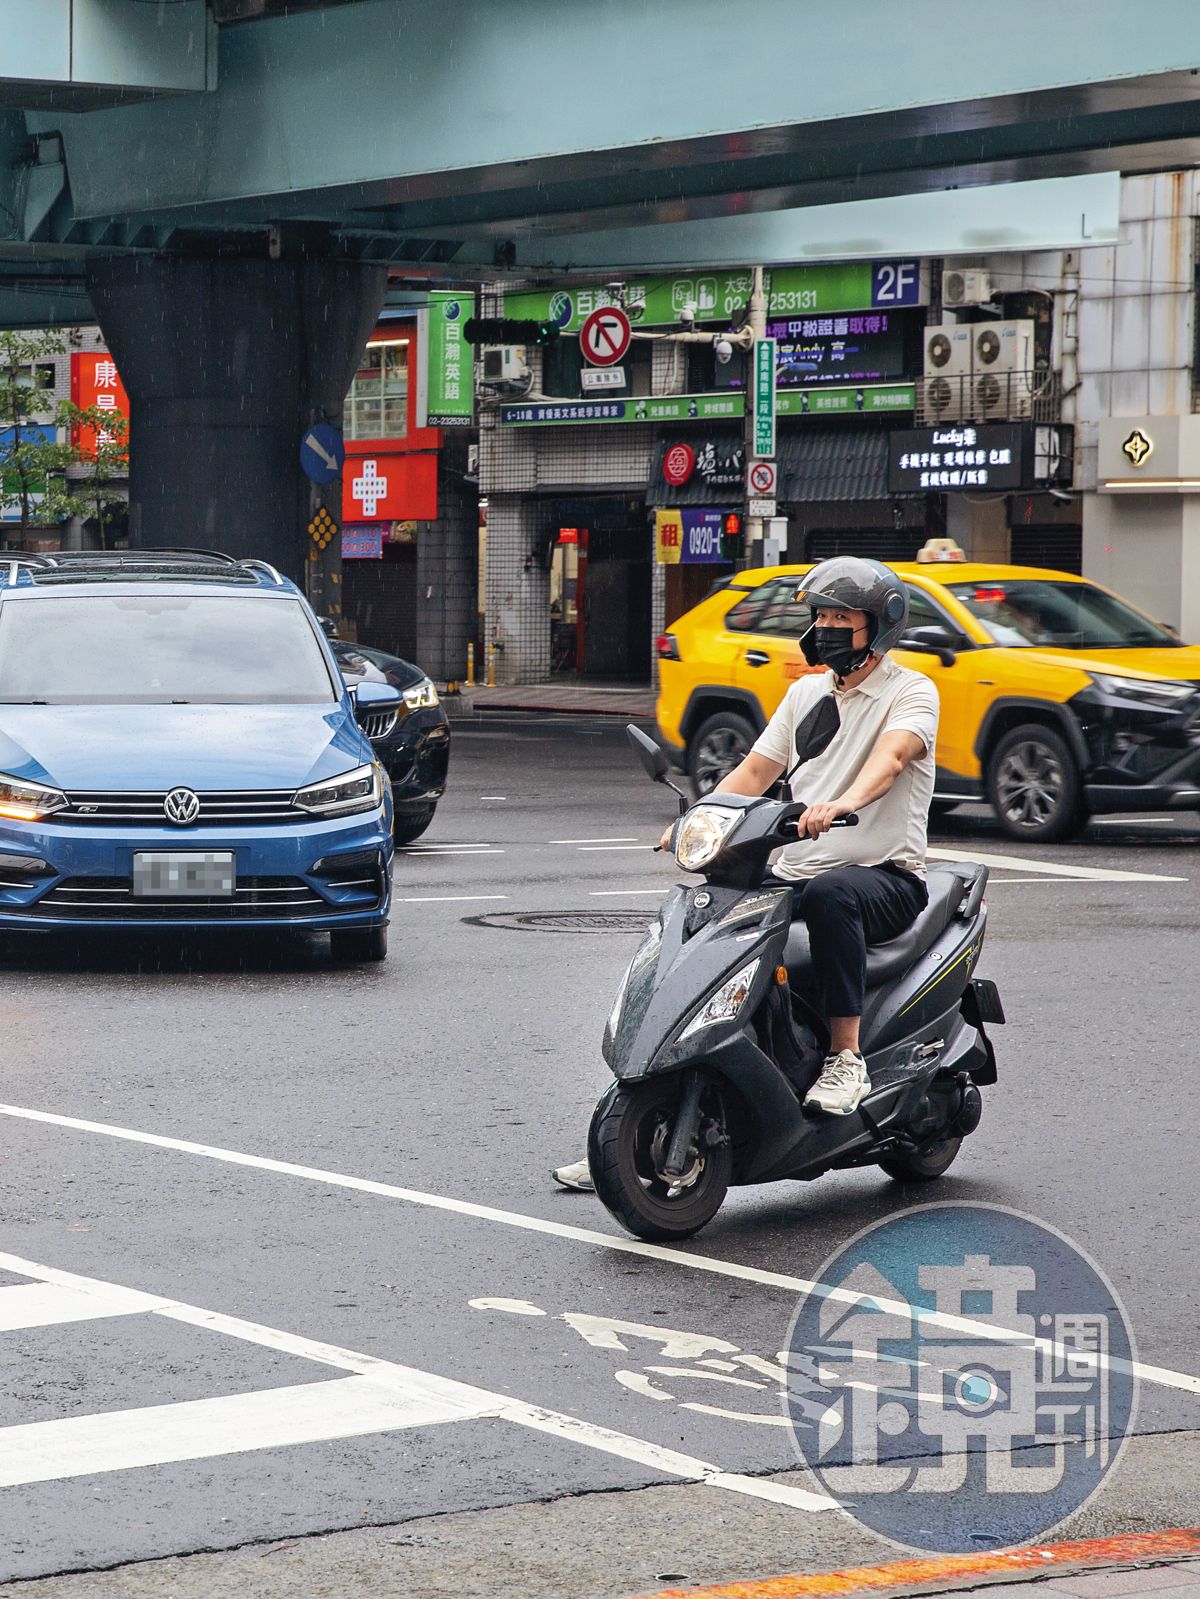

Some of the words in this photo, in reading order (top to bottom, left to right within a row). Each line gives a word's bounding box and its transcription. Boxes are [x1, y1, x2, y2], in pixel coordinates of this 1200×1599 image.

[876, 264, 915, 301] 2F
[723, 290, 818, 314] 02-253131
[445, 323, 460, 399] 百瀚英語
[661, 525, 679, 547] 租
